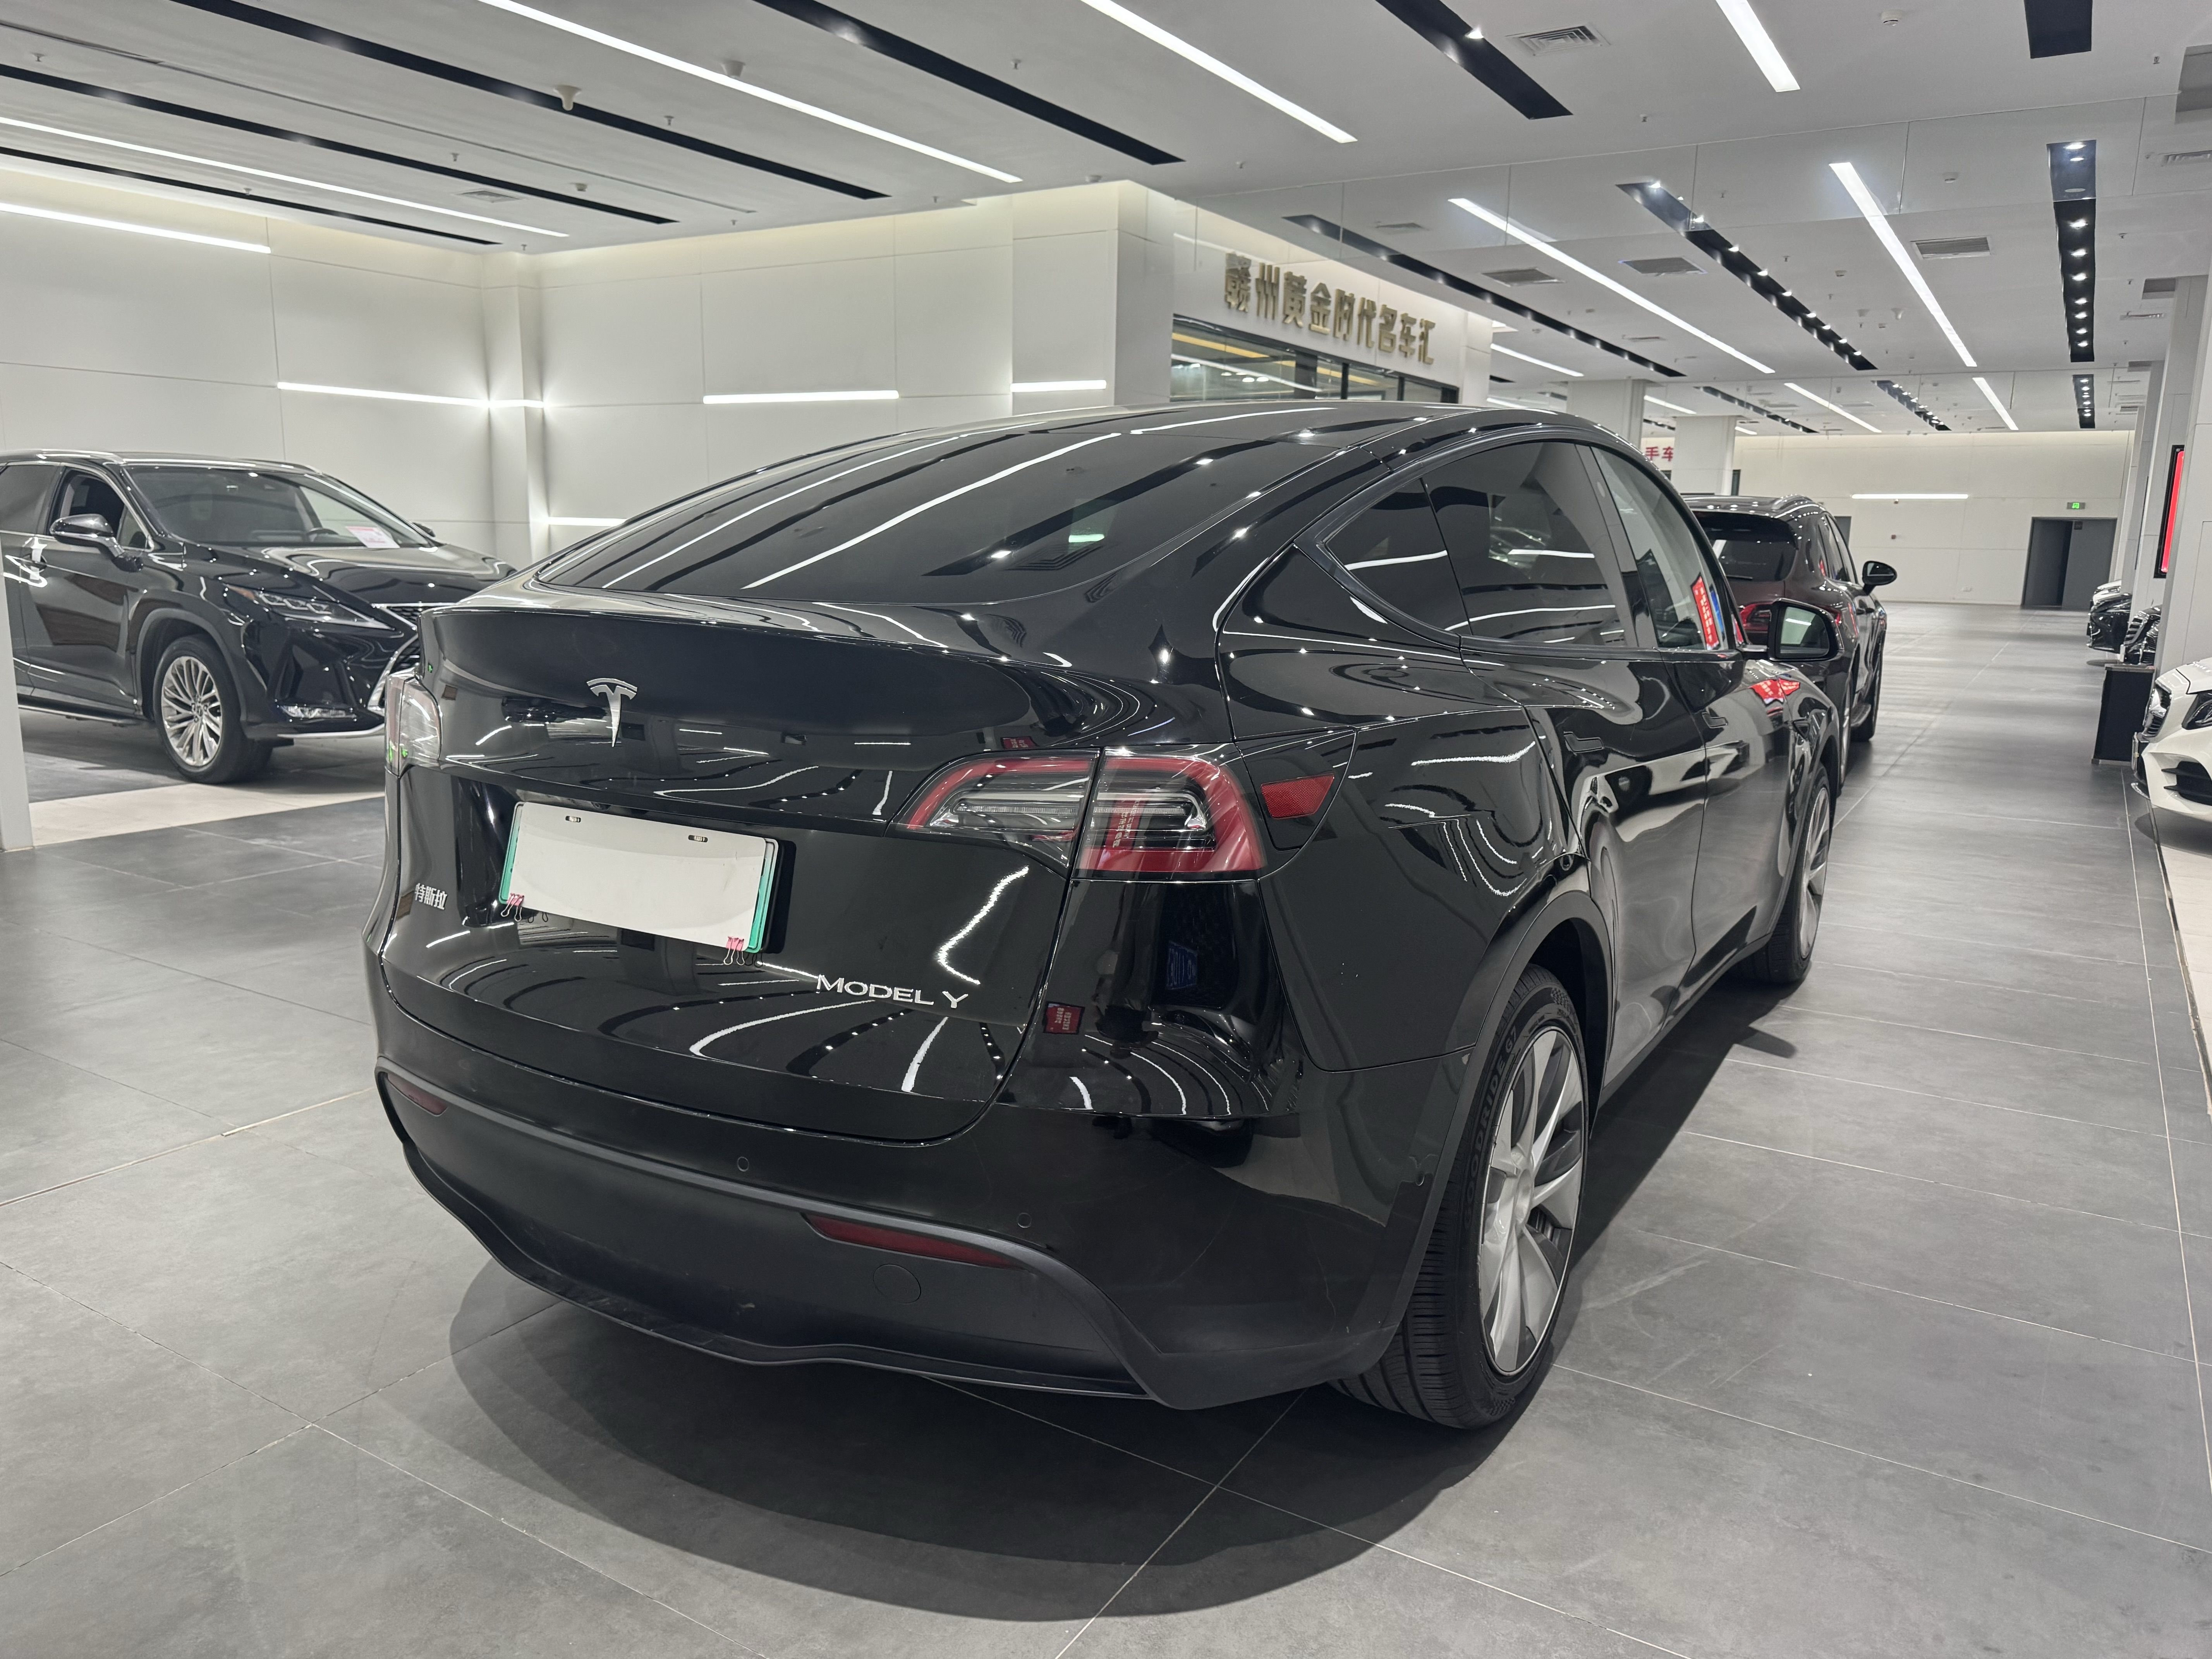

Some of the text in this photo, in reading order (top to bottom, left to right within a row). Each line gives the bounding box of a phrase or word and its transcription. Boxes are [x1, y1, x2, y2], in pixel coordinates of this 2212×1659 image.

[414, 883, 448, 910] 特斯拉
[816, 974, 969, 1008] MODEL Y
[1505, 1024, 1516, 1053] G7
